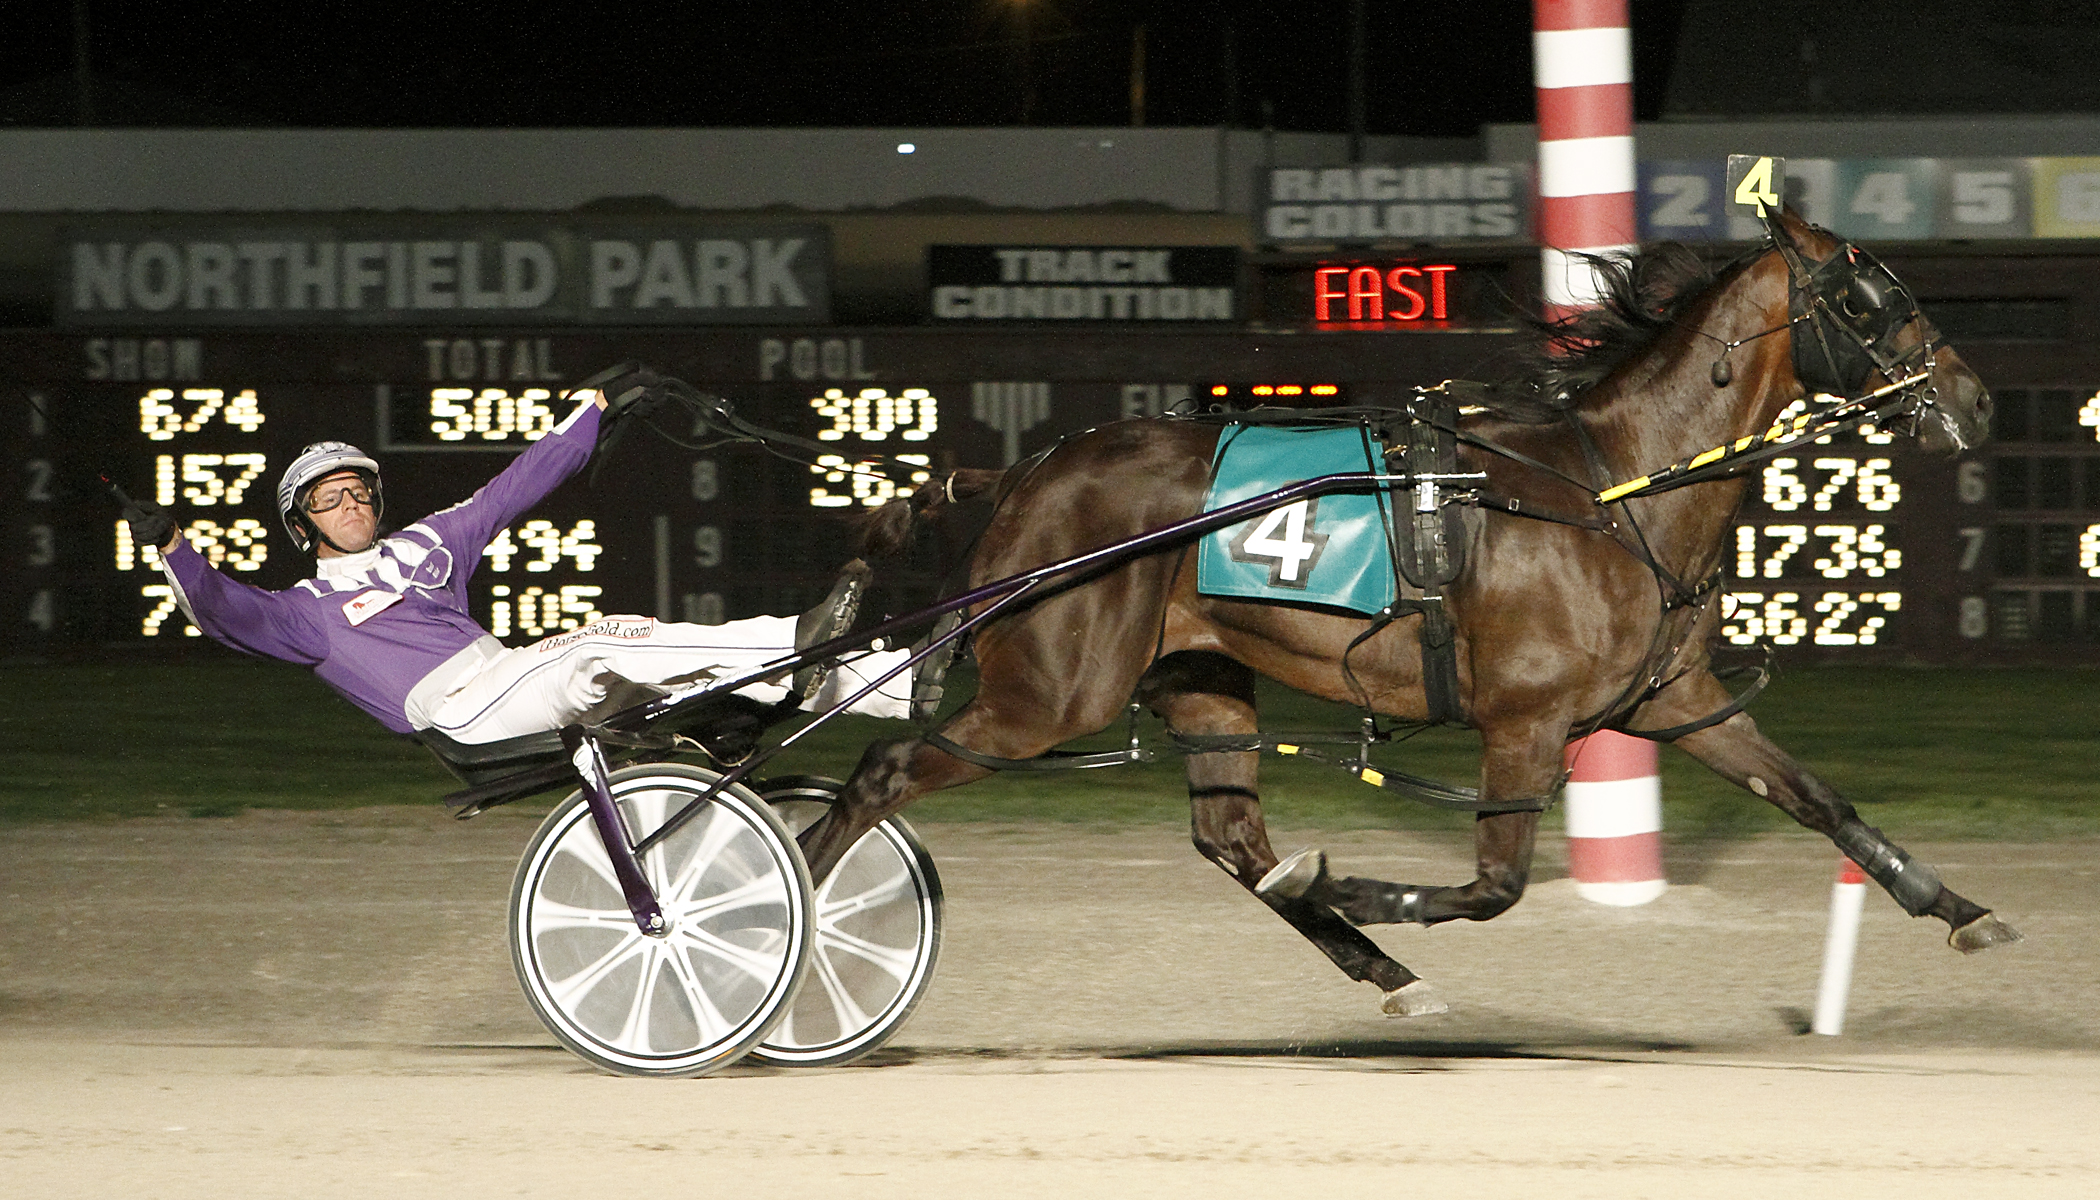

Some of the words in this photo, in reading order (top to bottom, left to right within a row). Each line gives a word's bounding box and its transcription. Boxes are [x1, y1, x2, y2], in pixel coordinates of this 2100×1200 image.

[1270, 166, 1512, 201] RACING
[1650, 175, 1711, 227] 2
[1735, 155, 1779, 218] 4
[1850, 172, 1915, 224] 4
[1952, 172, 2014, 222] 5
[1266, 203, 1517, 238] COLORS
[73, 241, 558, 310] NORTHFIELD
[588, 238, 810, 309] PARK
[995, 249, 1173, 283] TRACK
[932, 286, 1233, 320] CONDITION
[1313, 264, 1457, 321] FAST
[85, 339, 202, 382] SHOW
[425, 338, 560, 381] TOTAL
[760, 338, 874, 381] POOL
[139, 388, 265, 441] 674
[26, 458, 54, 502] 2
[155, 453, 266, 506] 157
[691, 459, 720, 502] 8
[1762, 457, 1901, 511] 676
[1958, 461, 1988, 504] 6
[27, 524, 55, 568] 3
[694, 525, 723, 567] 9
[1238, 496, 1321, 584] 4
[1959, 527, 1986, 571] 7
[28, 589, 54, 633] 4
[1720, 592, 1902, 645] 5627
[1958, 597, 1989, 639] 8
